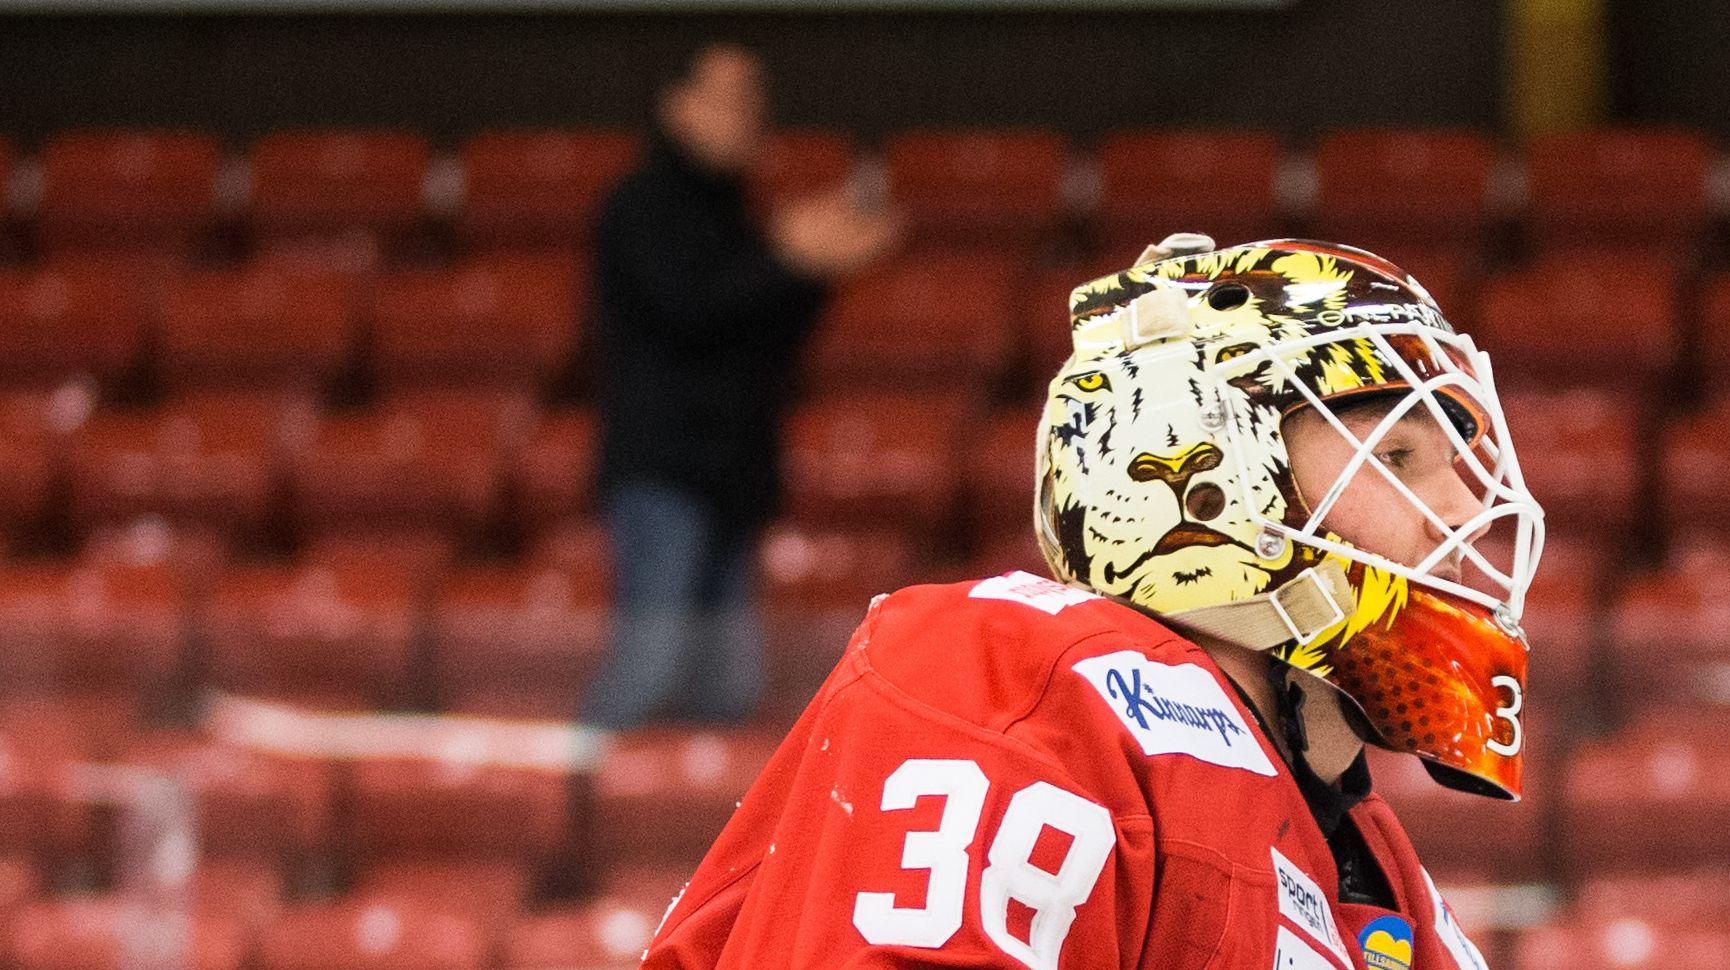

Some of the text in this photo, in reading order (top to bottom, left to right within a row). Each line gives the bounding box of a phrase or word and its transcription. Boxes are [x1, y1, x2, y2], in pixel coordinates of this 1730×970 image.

[1106, 668, 1246, 747] Kinnarps
[1485, 676, 1522, 756] 3
[1279, 867, 1320, 920] sport
